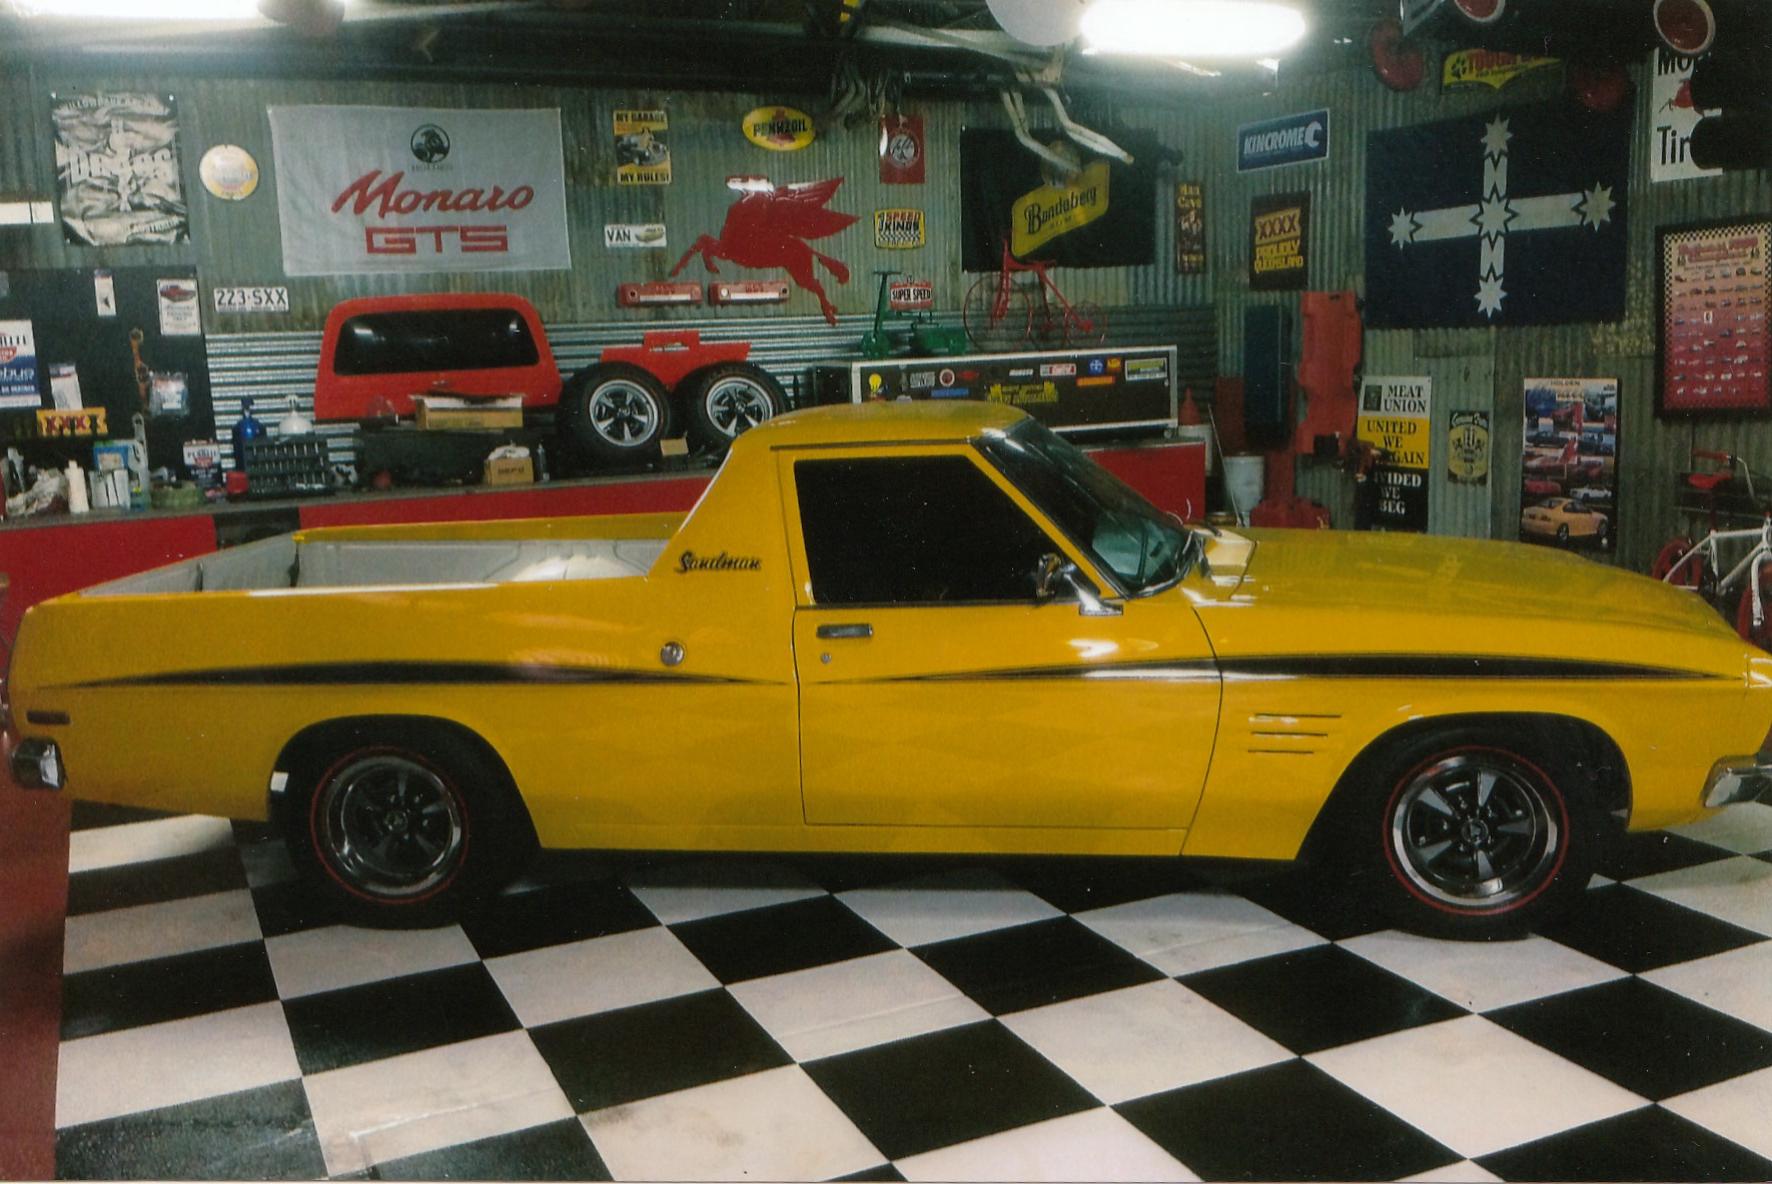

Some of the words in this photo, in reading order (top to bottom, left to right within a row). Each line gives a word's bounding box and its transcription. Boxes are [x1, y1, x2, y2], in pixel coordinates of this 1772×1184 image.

[1243, 126, 1305, 155] KINCROME
[331, 169, 535, 219] Monaro
[1024, 186, 1097, 234] Bundaberg
[607, 229, 631, 242] VAN
[1258, 213, 1297, 240] XXXX
[365, 224, 508, 254] GTS
[892, 289, 911, 301] SUPER
[1387, 384, 1424, 398] MEAT
[1384, 398, 1426, 413] UNION
[1366, 419, 1417, 435] UNITED
[1383, 435, 1403, 449] WE
[674, 550, 761, 574] Sandman
